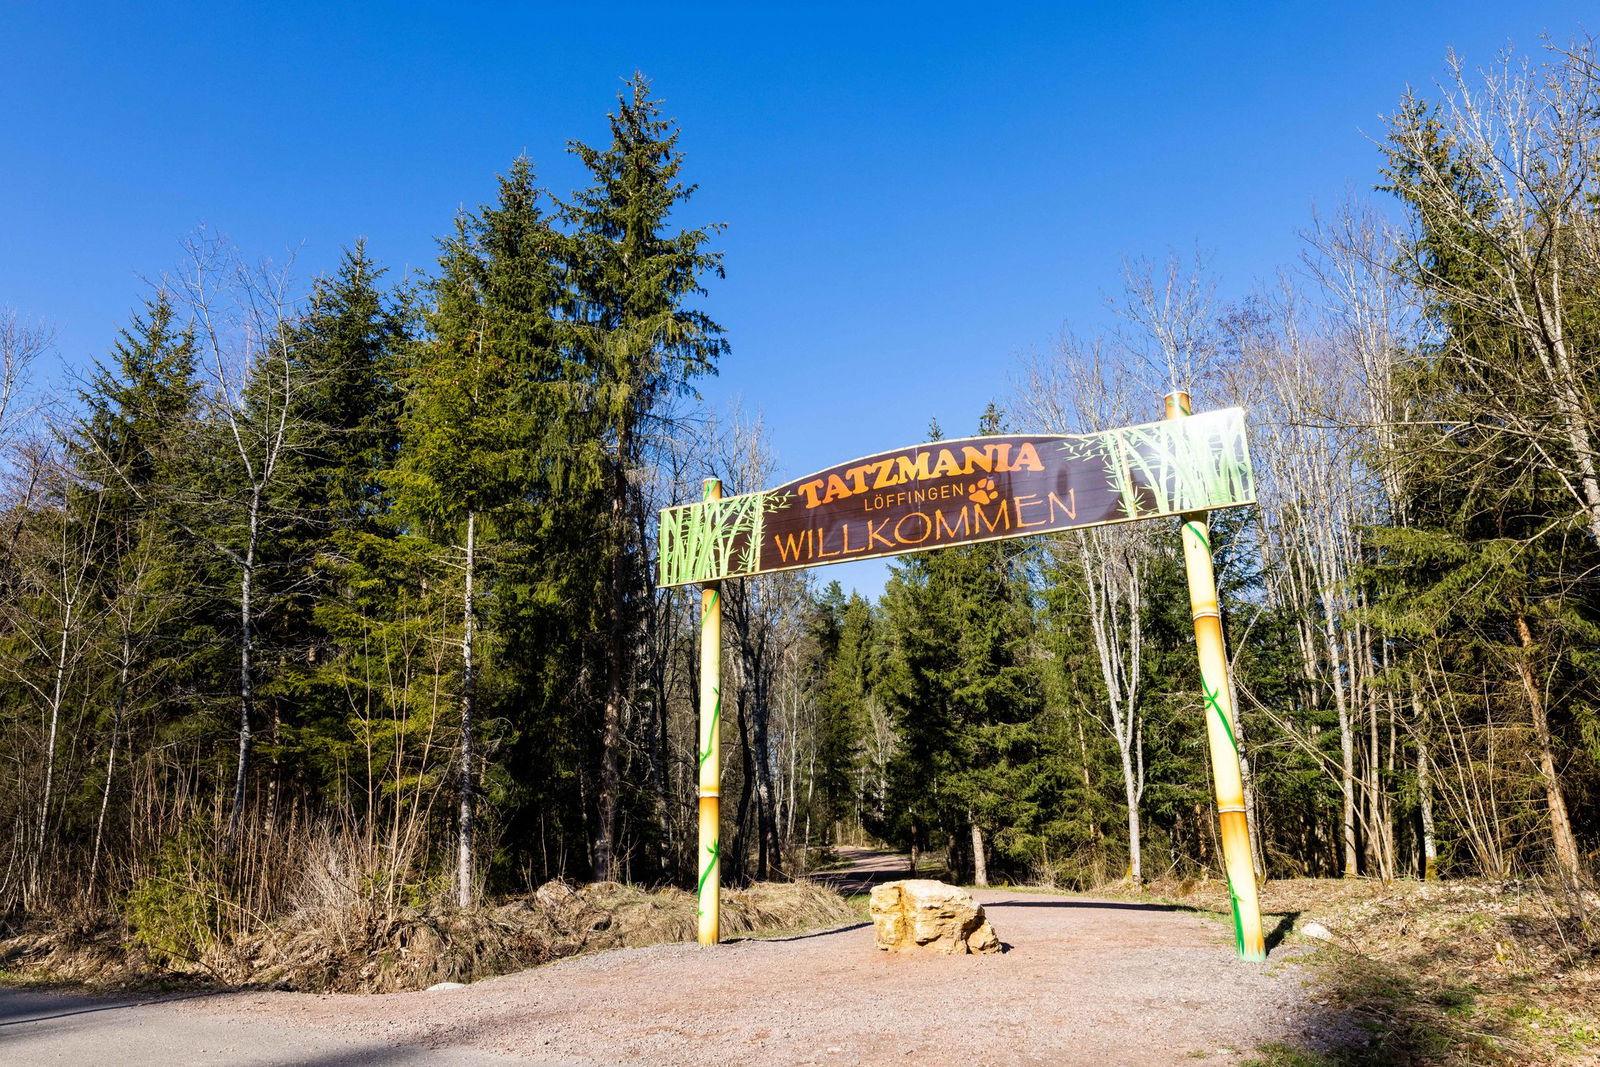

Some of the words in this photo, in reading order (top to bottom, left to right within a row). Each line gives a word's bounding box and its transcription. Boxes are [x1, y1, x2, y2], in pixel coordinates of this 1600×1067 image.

[798, 442, 1045, 509] TATZMANIA
[864, 483, 964, 511] LÖFFINGEN
[774, 488, 1077, 563] WILLKOMMEN
